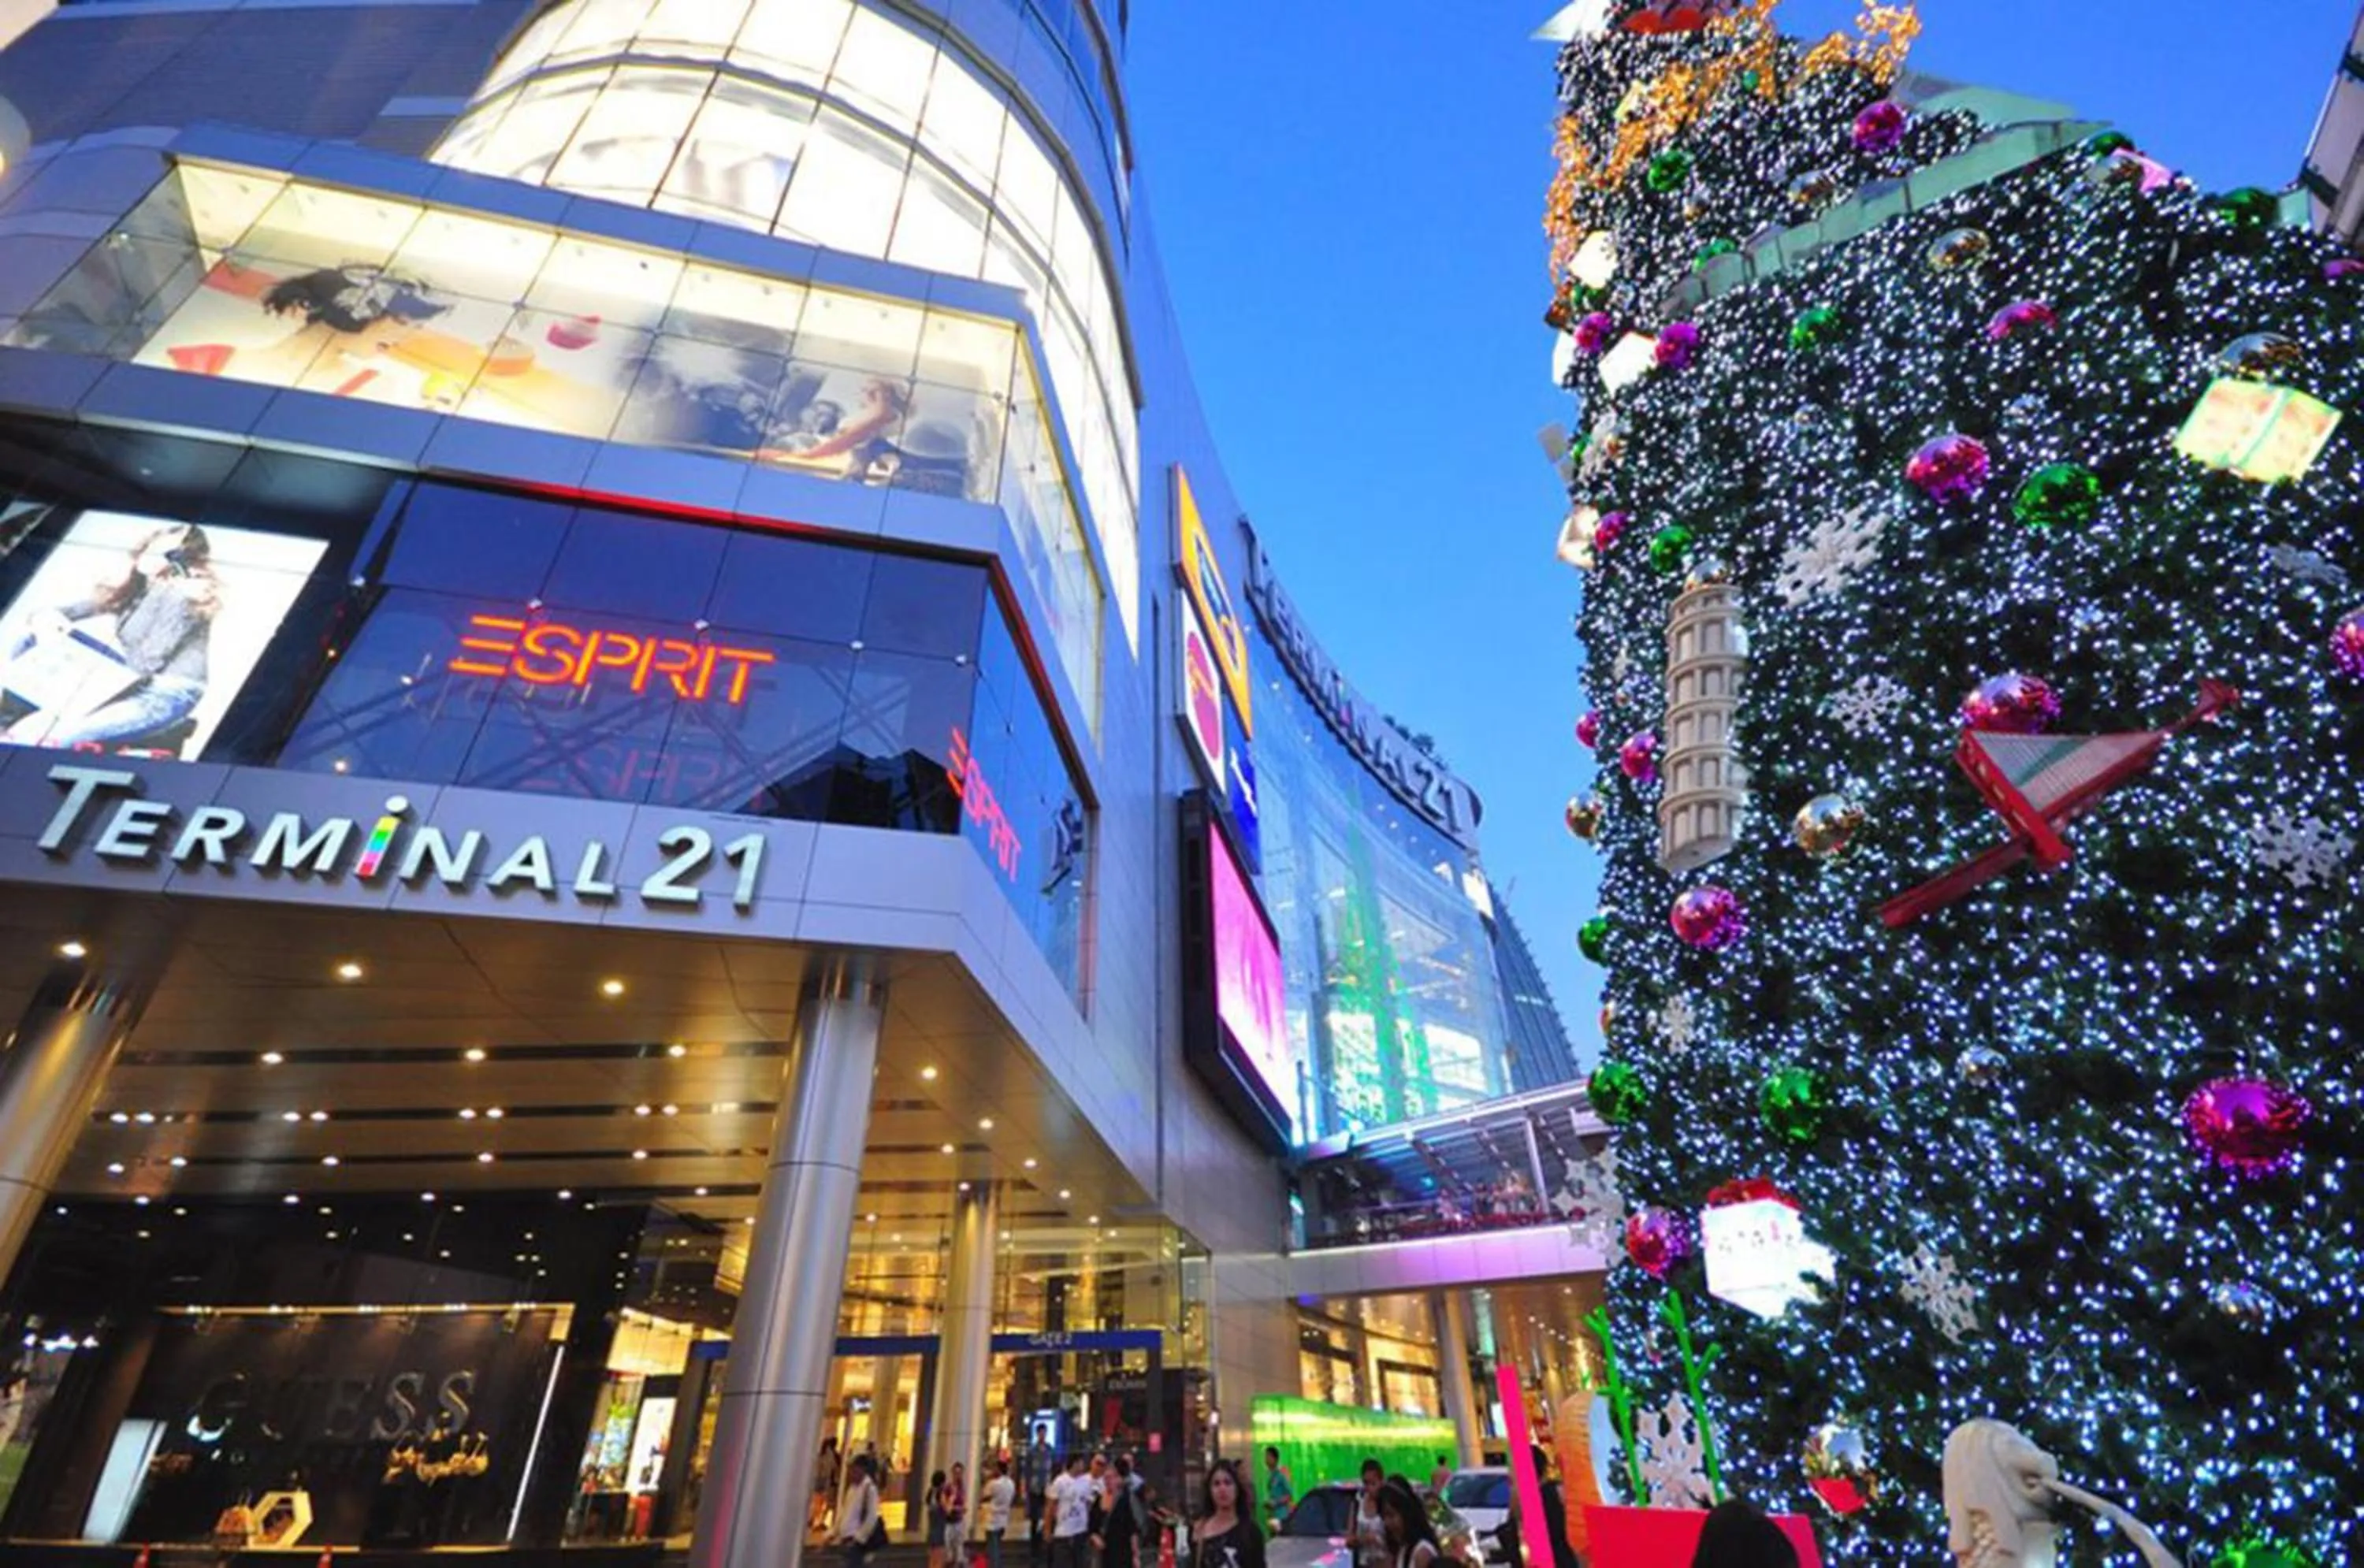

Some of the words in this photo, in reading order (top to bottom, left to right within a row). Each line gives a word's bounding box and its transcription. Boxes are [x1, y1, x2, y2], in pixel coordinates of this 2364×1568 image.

[448, 613, 776, 704] ESPRIT
[947, 726, 1022, 883] ESPRIT
[1414, 760, 1462, 834] 21
[640, 825, 768, 911] 21
